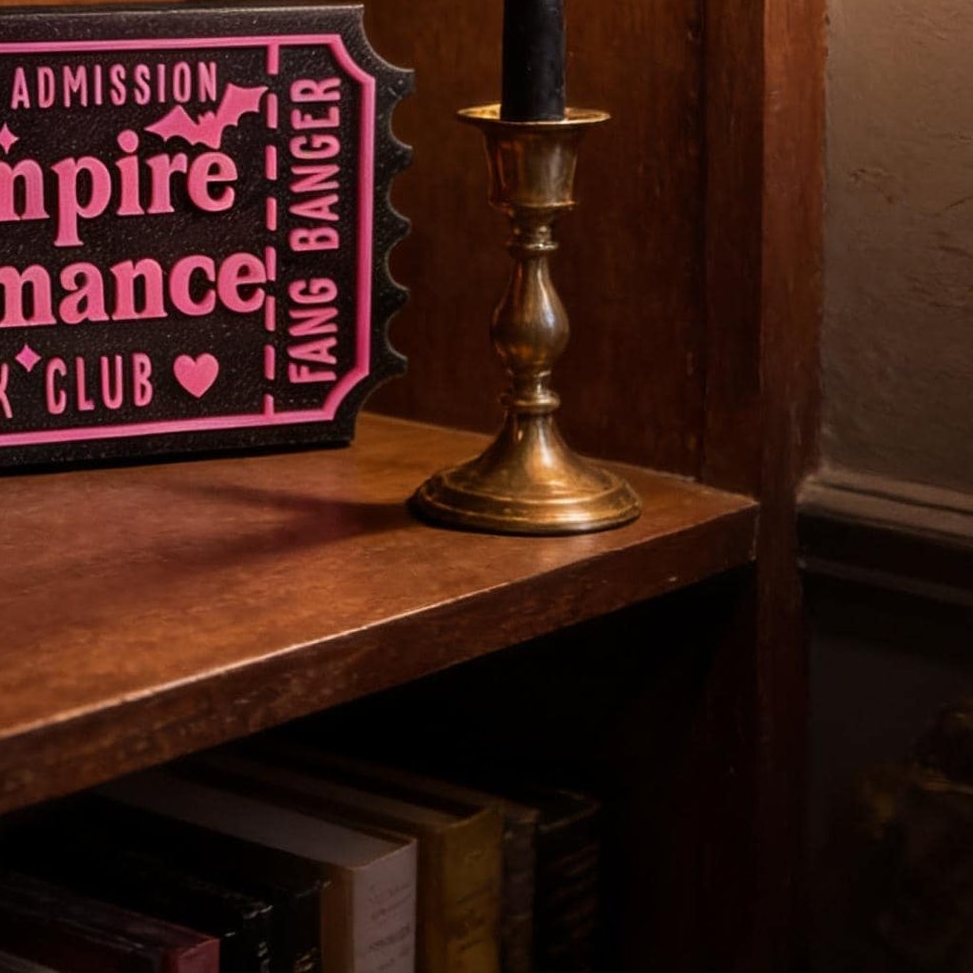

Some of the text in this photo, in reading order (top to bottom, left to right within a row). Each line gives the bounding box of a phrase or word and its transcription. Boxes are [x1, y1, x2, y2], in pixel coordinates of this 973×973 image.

[11, 61, 217, 110] ADMISSION
[288, 77, 342, 385] FANG BANGER
[45, 352, 153, 411] CLUB
